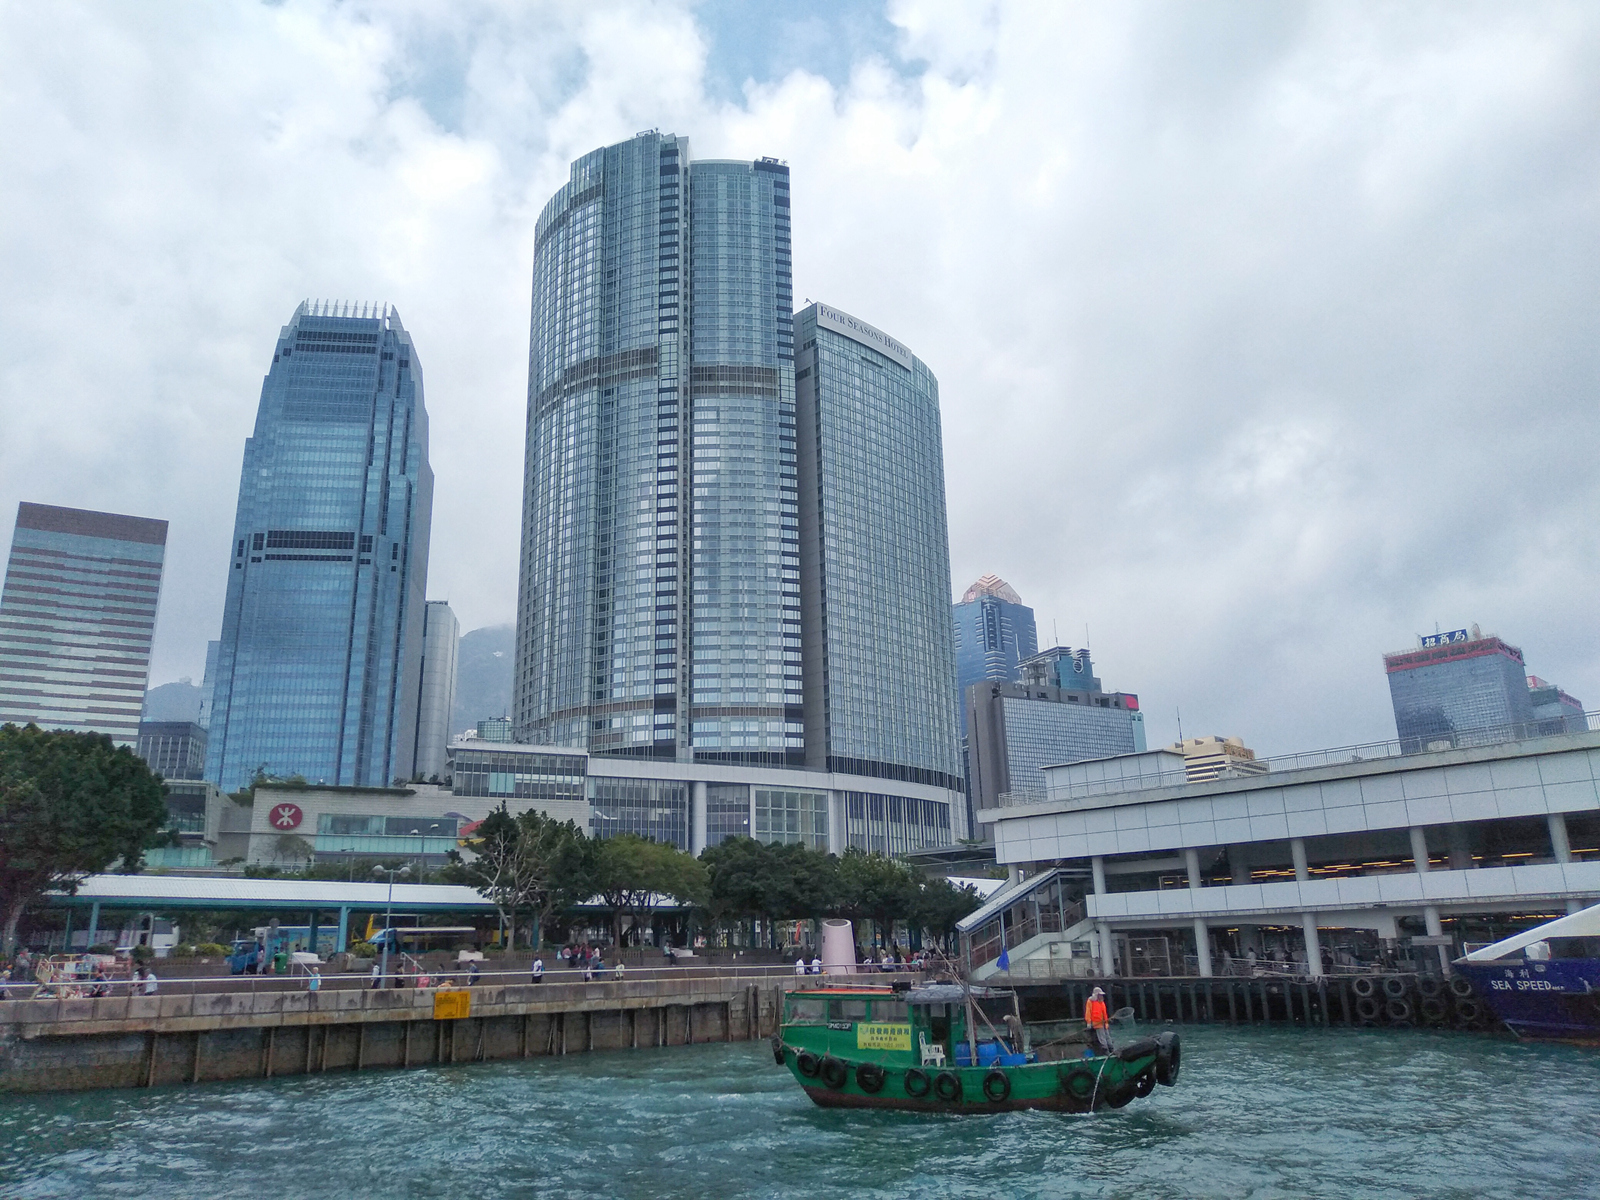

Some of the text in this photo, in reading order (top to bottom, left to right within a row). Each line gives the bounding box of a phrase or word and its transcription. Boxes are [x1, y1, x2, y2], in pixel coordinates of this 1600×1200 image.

[820, 305, 909, 359] FOUR SEASONS HOTEL
[1424, 631, 1465, 648] 招商局
[1491, 980, 1512, 990] SEA
[1516, 980, 1551, 991] SPEED
